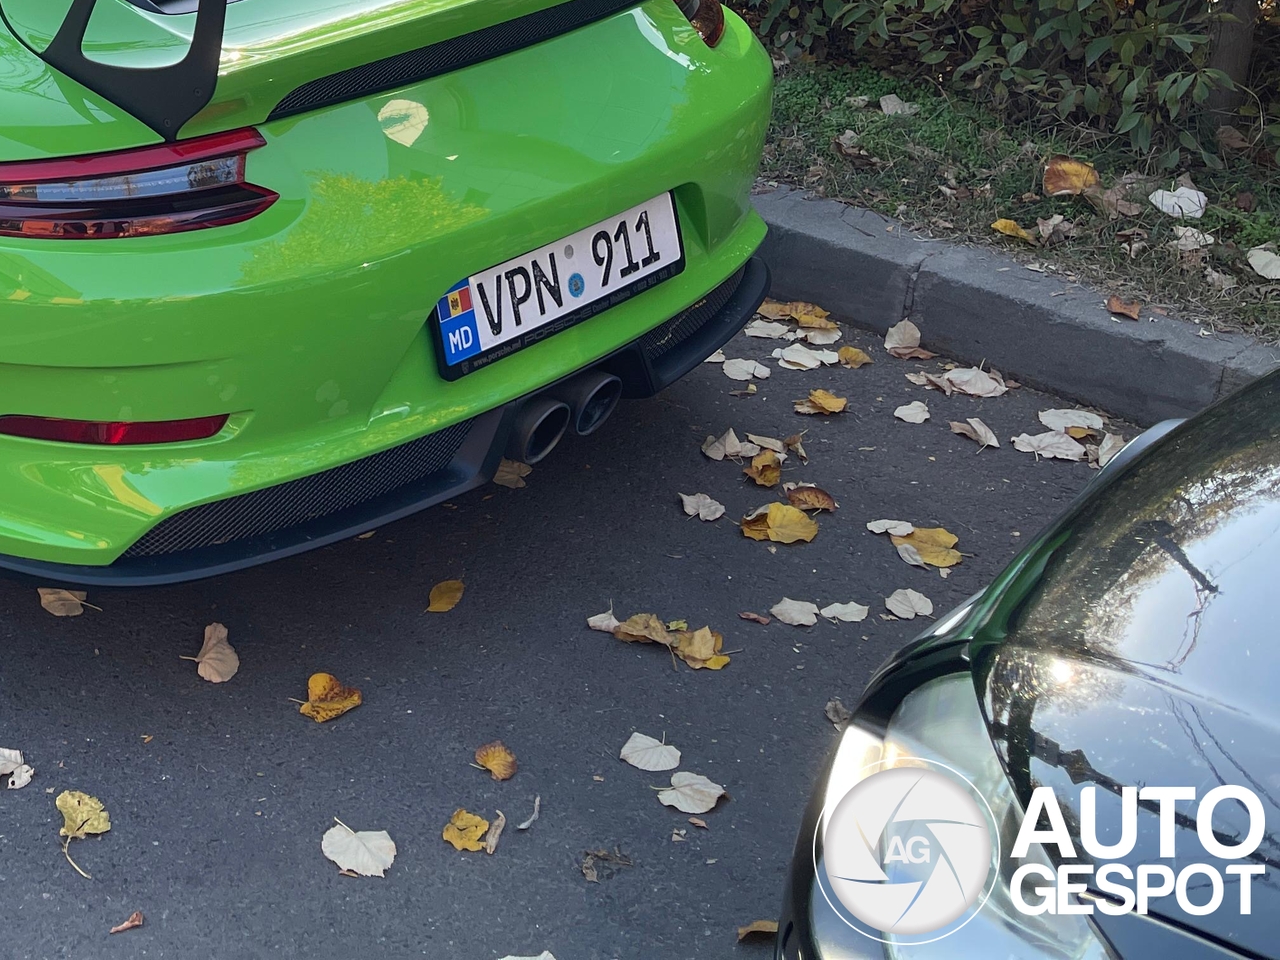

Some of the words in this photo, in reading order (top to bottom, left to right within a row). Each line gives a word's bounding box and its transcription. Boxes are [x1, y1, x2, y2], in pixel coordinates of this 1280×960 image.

[477, 252, 563, 336] VPN
[591, 210, 661, 288] 911
[448, 326, 473, 354] MD
[524, 308, 593, 345] PORSCHE
